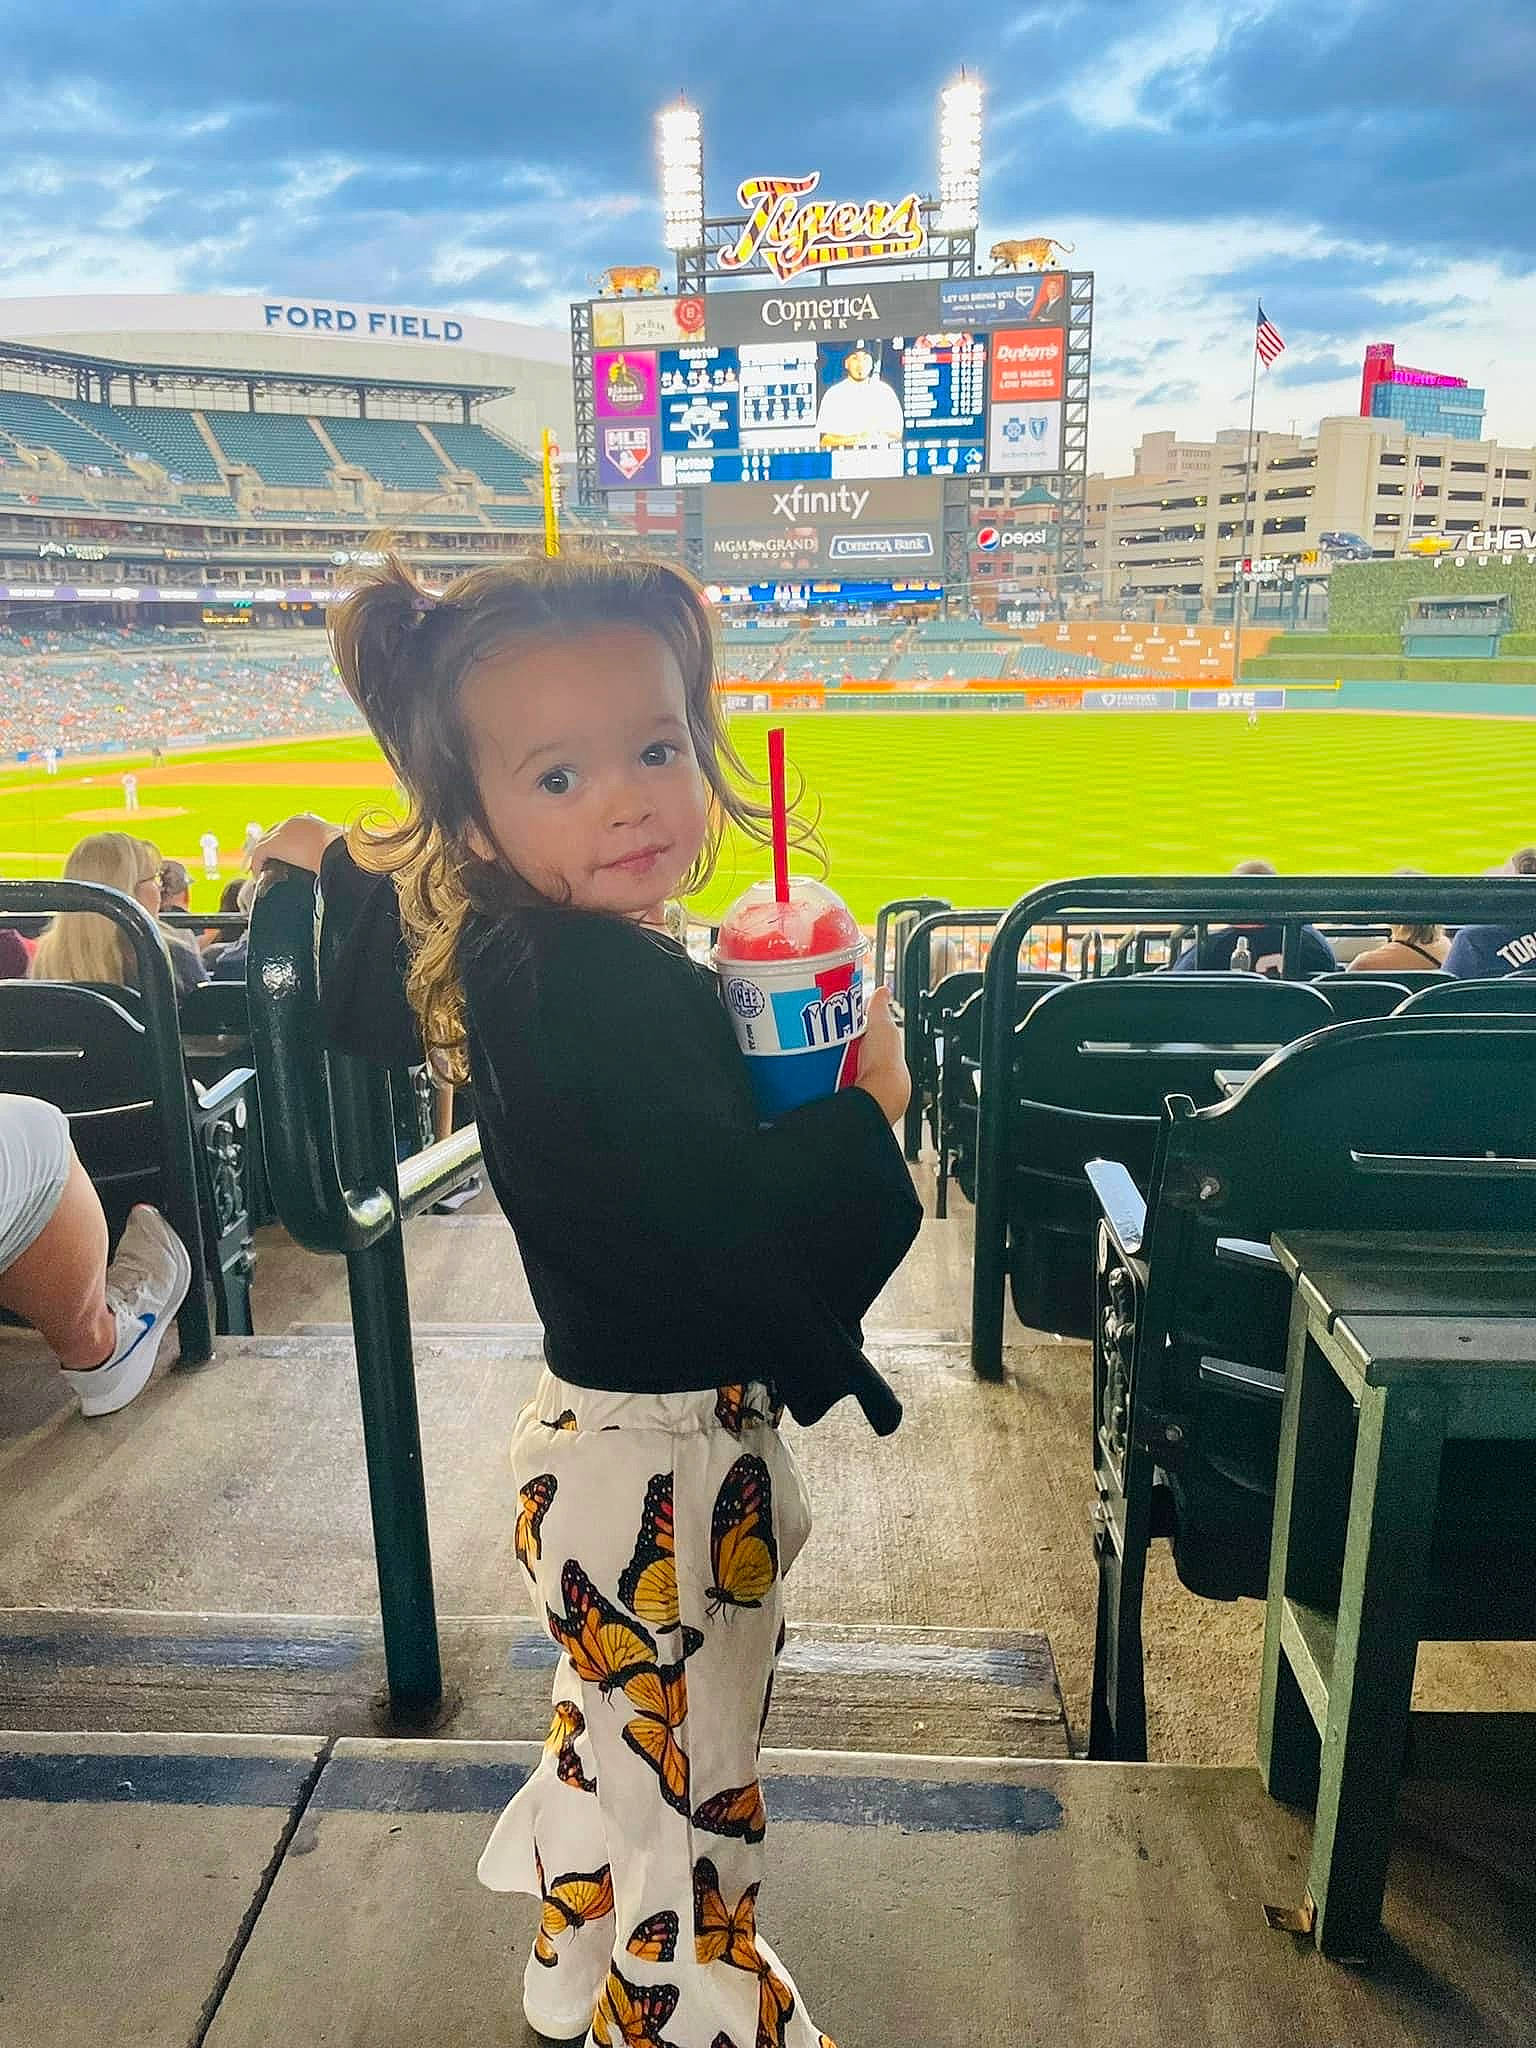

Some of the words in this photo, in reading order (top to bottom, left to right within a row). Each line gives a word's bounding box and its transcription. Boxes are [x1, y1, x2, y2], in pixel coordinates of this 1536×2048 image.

[717, 170, 928, 284] Tigers
[997, 290, 1015, 300] YOU
[264, 305, 357, 331] FORD
[367, 312, 464, 342] FIELD
[793, 319, 848, 332] PARK
[772, 485, 870, 522] xfinity
[714, 541, 750, 553] MGM
[767, 538, 816, 552] GRAND
[1001, 528, 1047, 548] pepsi
[1217, 692, 1256, 706] DTE
